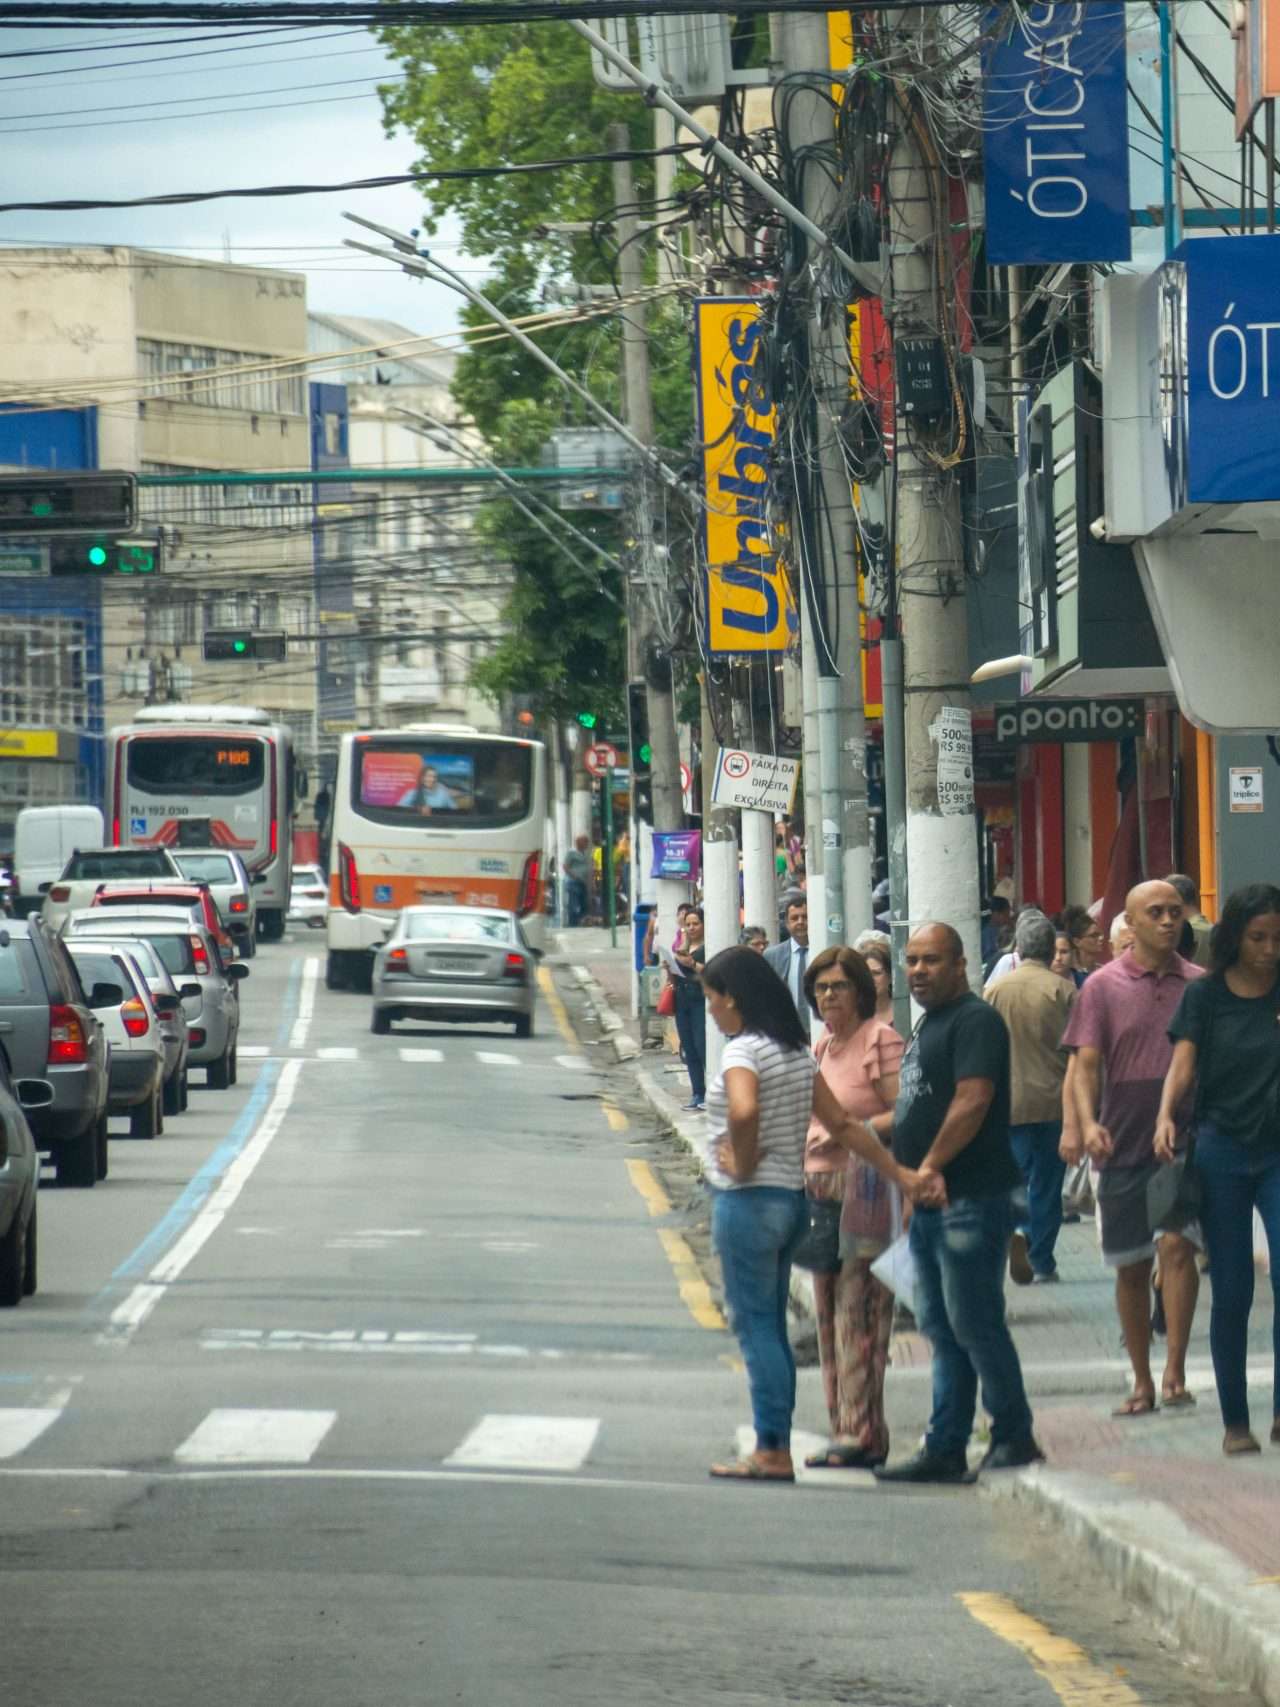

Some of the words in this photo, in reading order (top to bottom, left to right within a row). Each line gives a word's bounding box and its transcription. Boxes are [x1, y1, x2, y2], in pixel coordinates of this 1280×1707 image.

[1010, 3, 1088, 218] ÓTICAS
[714, 317, 779, 636] Unibrás
[942, 728, 962, 741] 500
[751, 758, 779, 772] FAIXA
[781, 763, 795, 774] DA
[752, 778, 789, 792] DIREITA
[734, 794, 788, 809] EXCLUSIVA
